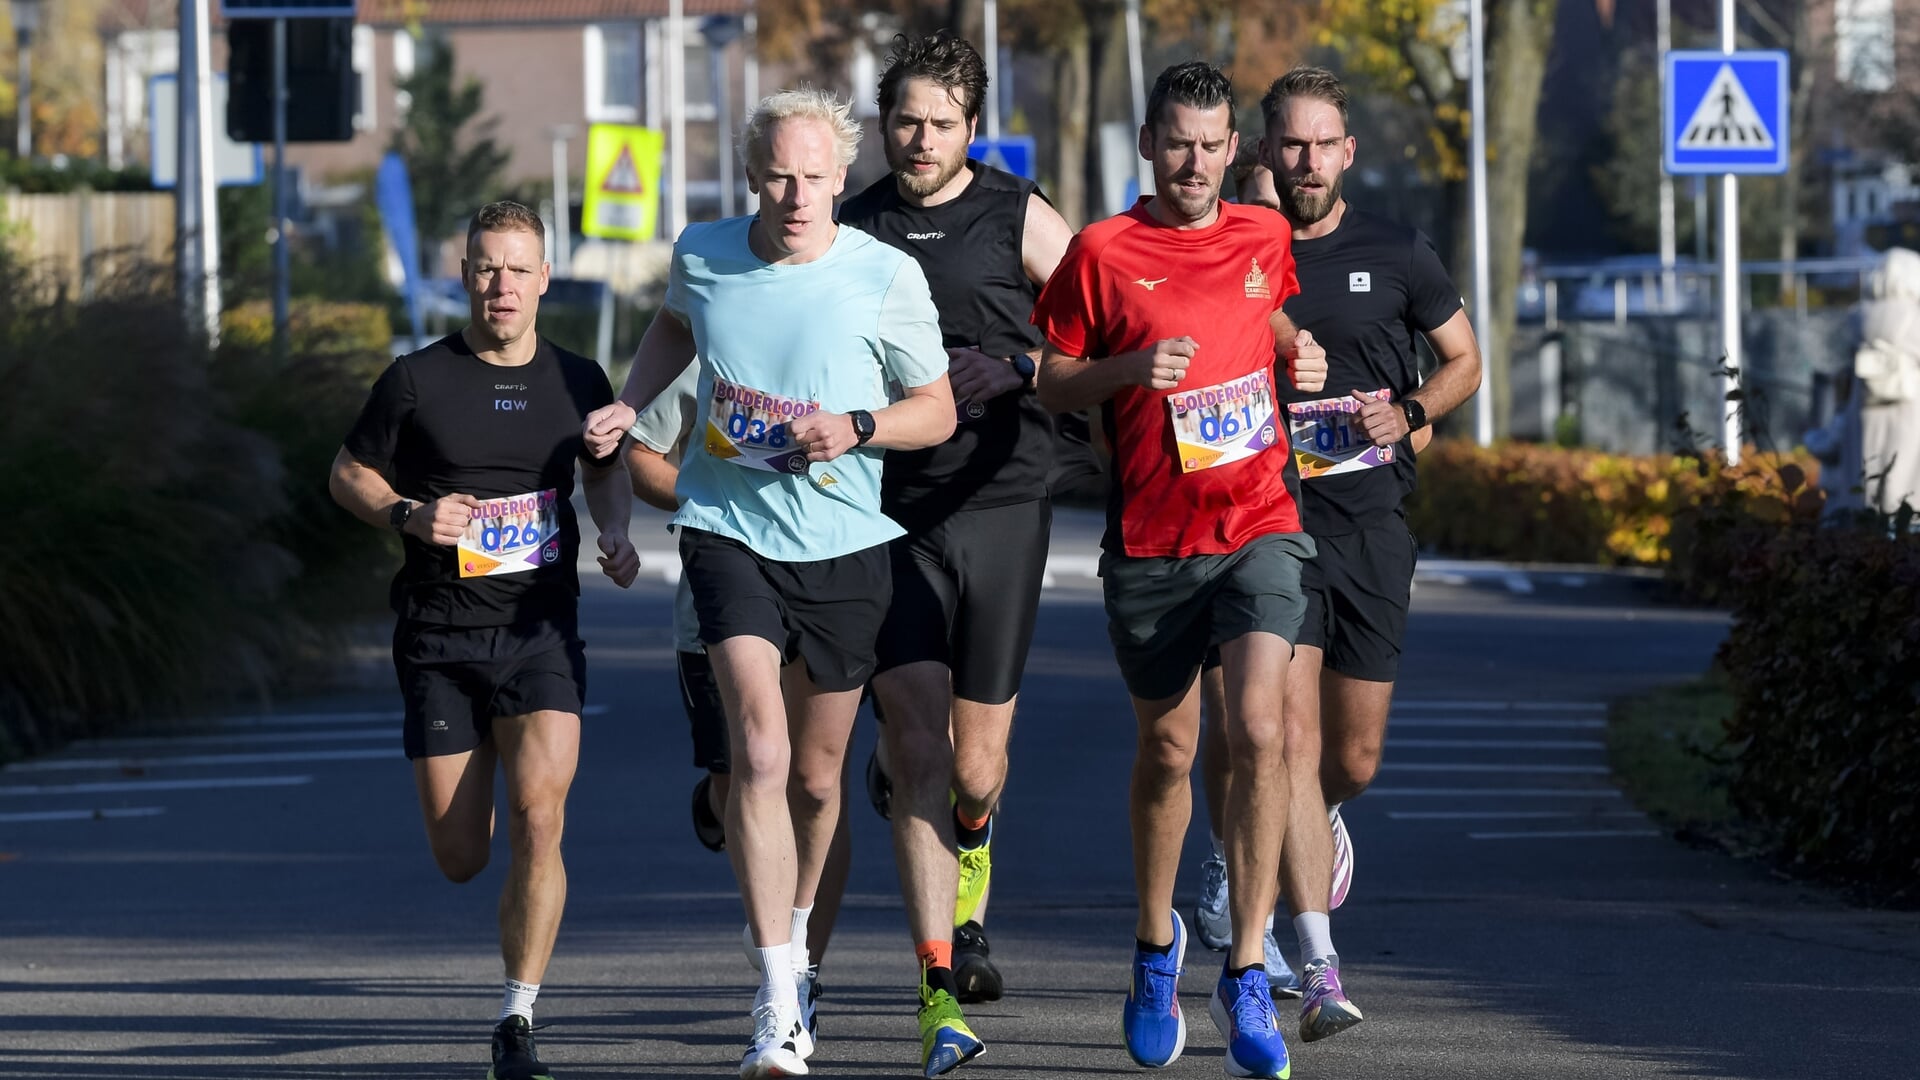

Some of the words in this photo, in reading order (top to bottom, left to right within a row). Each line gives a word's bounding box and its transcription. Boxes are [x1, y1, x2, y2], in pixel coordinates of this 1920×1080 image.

[907, 232, 938, 240] CRAFT
[495, 399, 528, 410] raw
[728, 413, 787, 449] 038
[1200, 405, 1253, 442] 061
[1316, 425, 1373, 452] 01
[481, 521, 540, 551] 026
